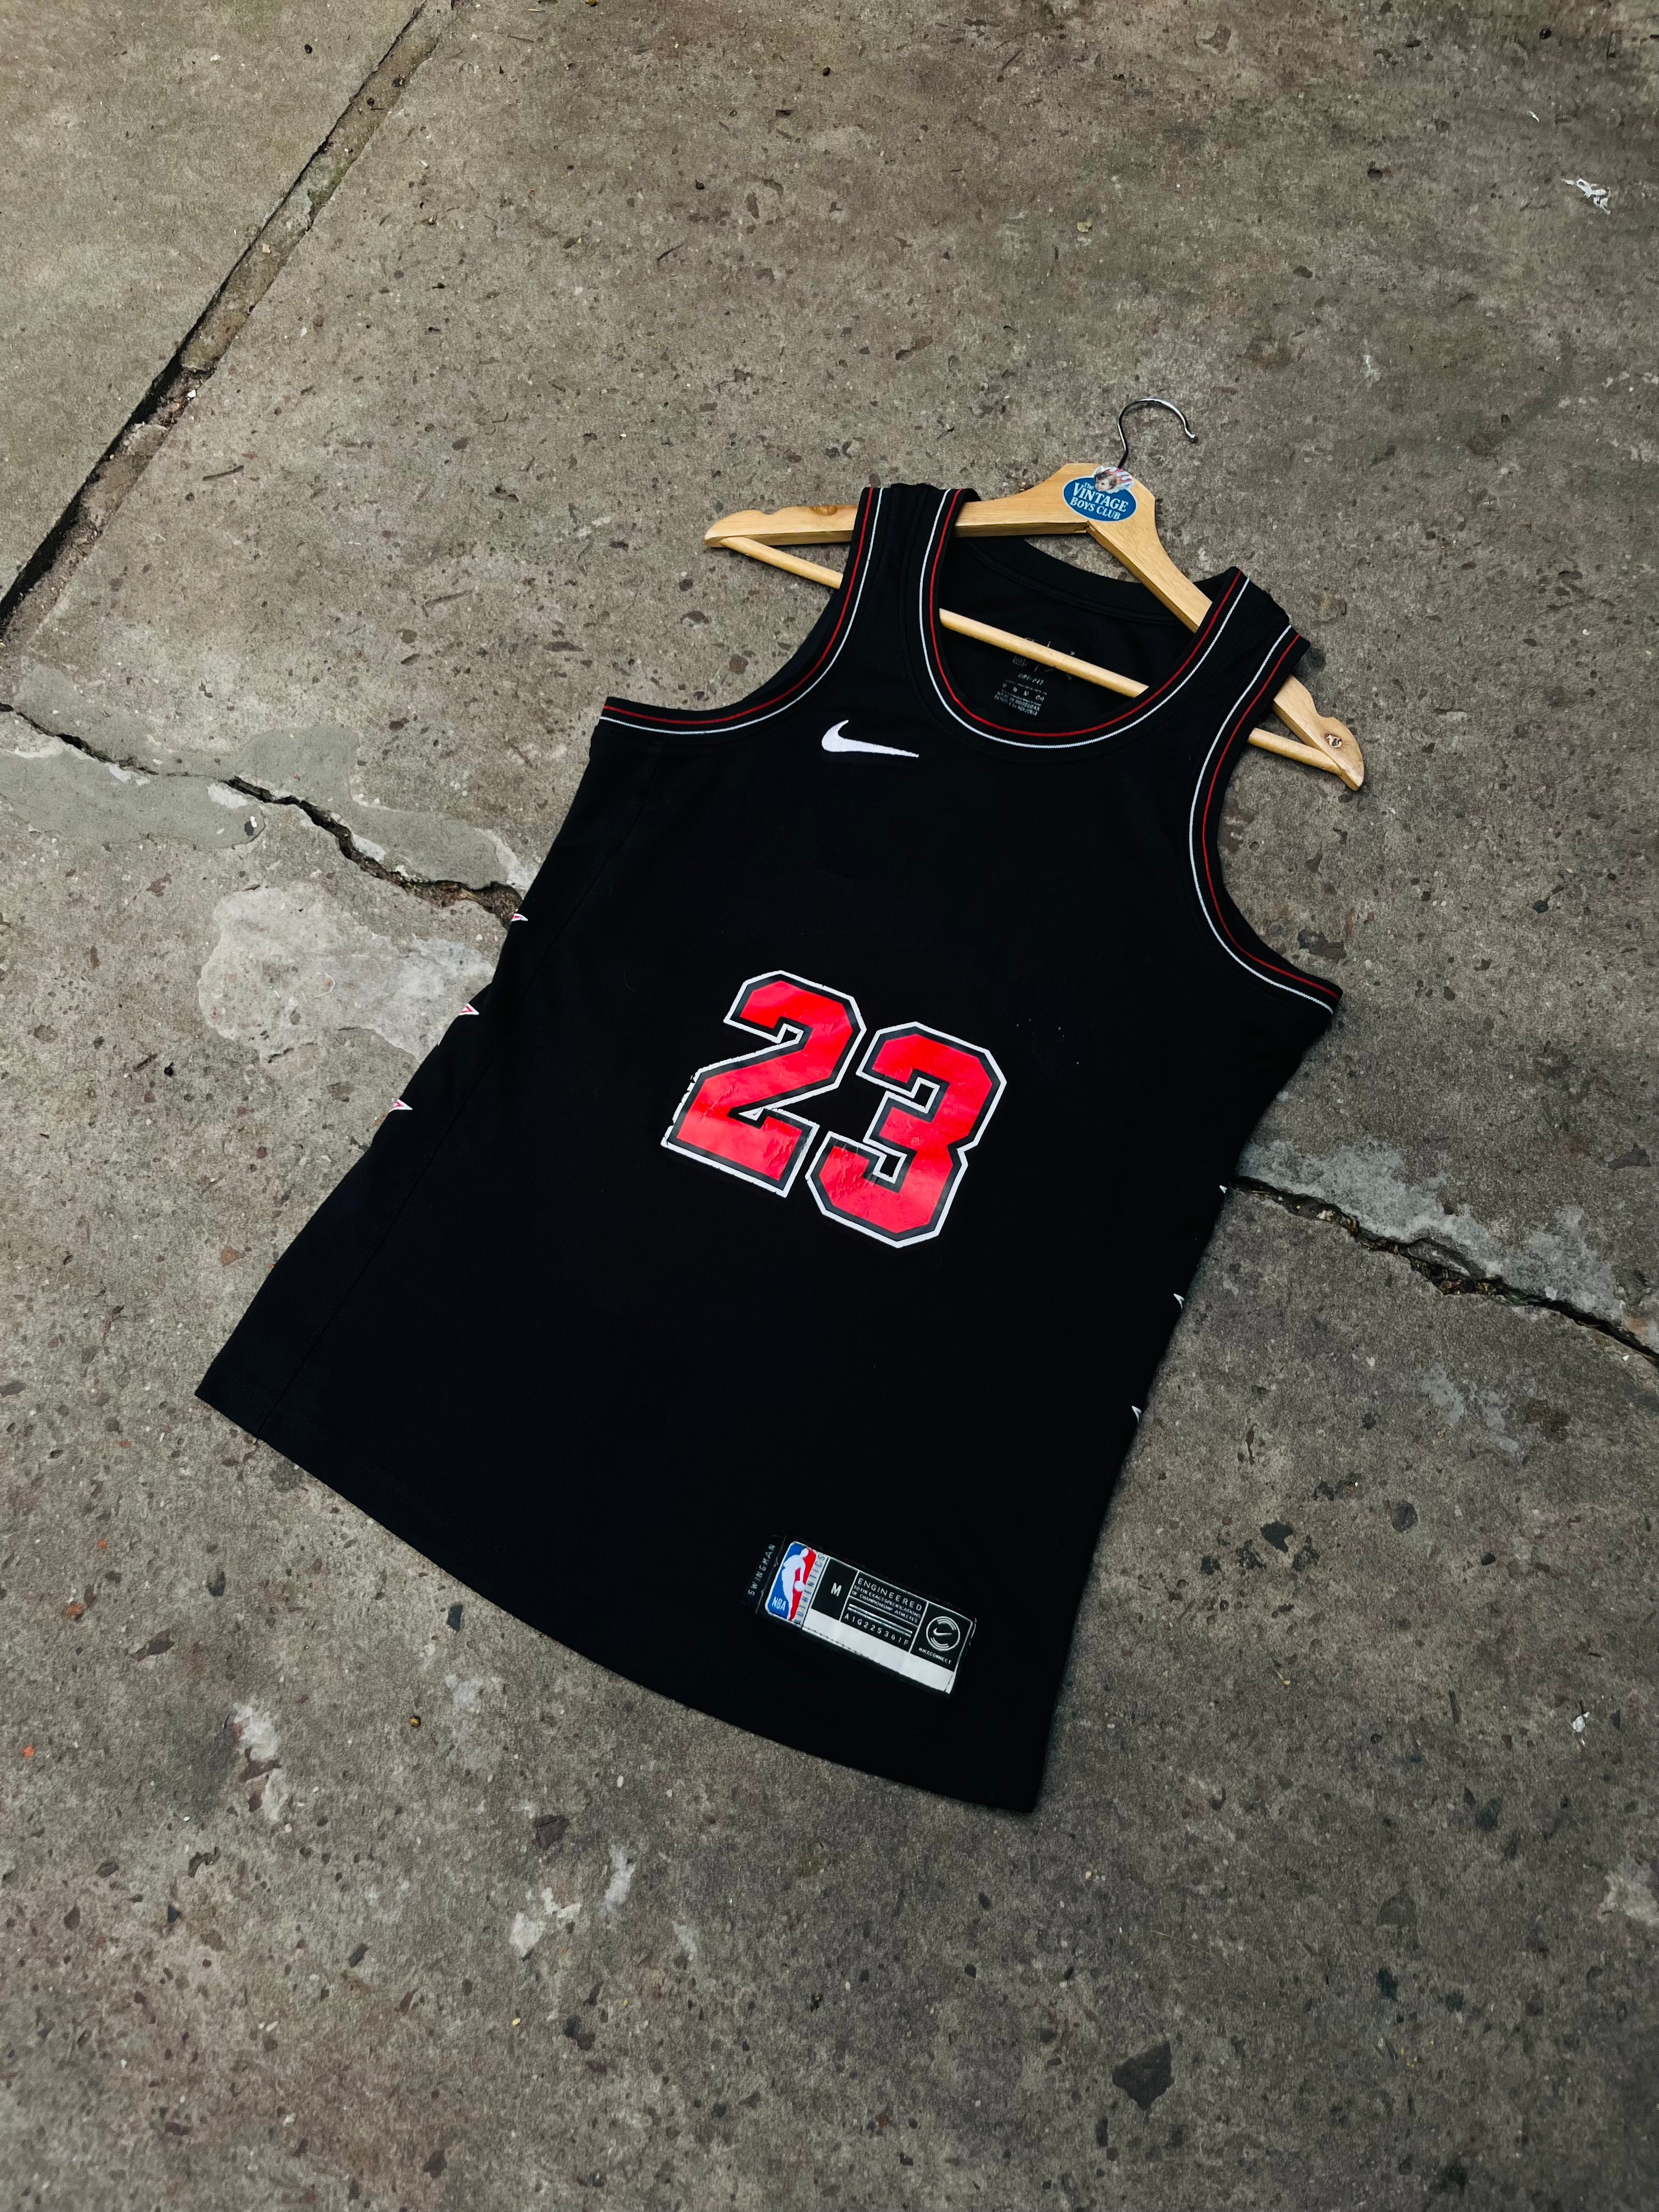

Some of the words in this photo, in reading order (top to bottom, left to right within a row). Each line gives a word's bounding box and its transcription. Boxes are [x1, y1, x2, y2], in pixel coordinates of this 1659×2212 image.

[1070, 496, 1095, 512] BOYS
[1097, 506, 1121, 520] CLUB
[1073, 482, 1128, 512] VINTAGE
[661, 970, 1007, 1248] 23
[748, 1544, 776, 1596] SWINGMAN
[771, 1596, 787, 1611] NBA
[794, 1554, 826, 1625] AUTHENTICS
[830, 1583, 842, 1597] M
[857, 1578, 922, 1611] ENGINEERED
[868, 1592, 885, 1602] EXACT
